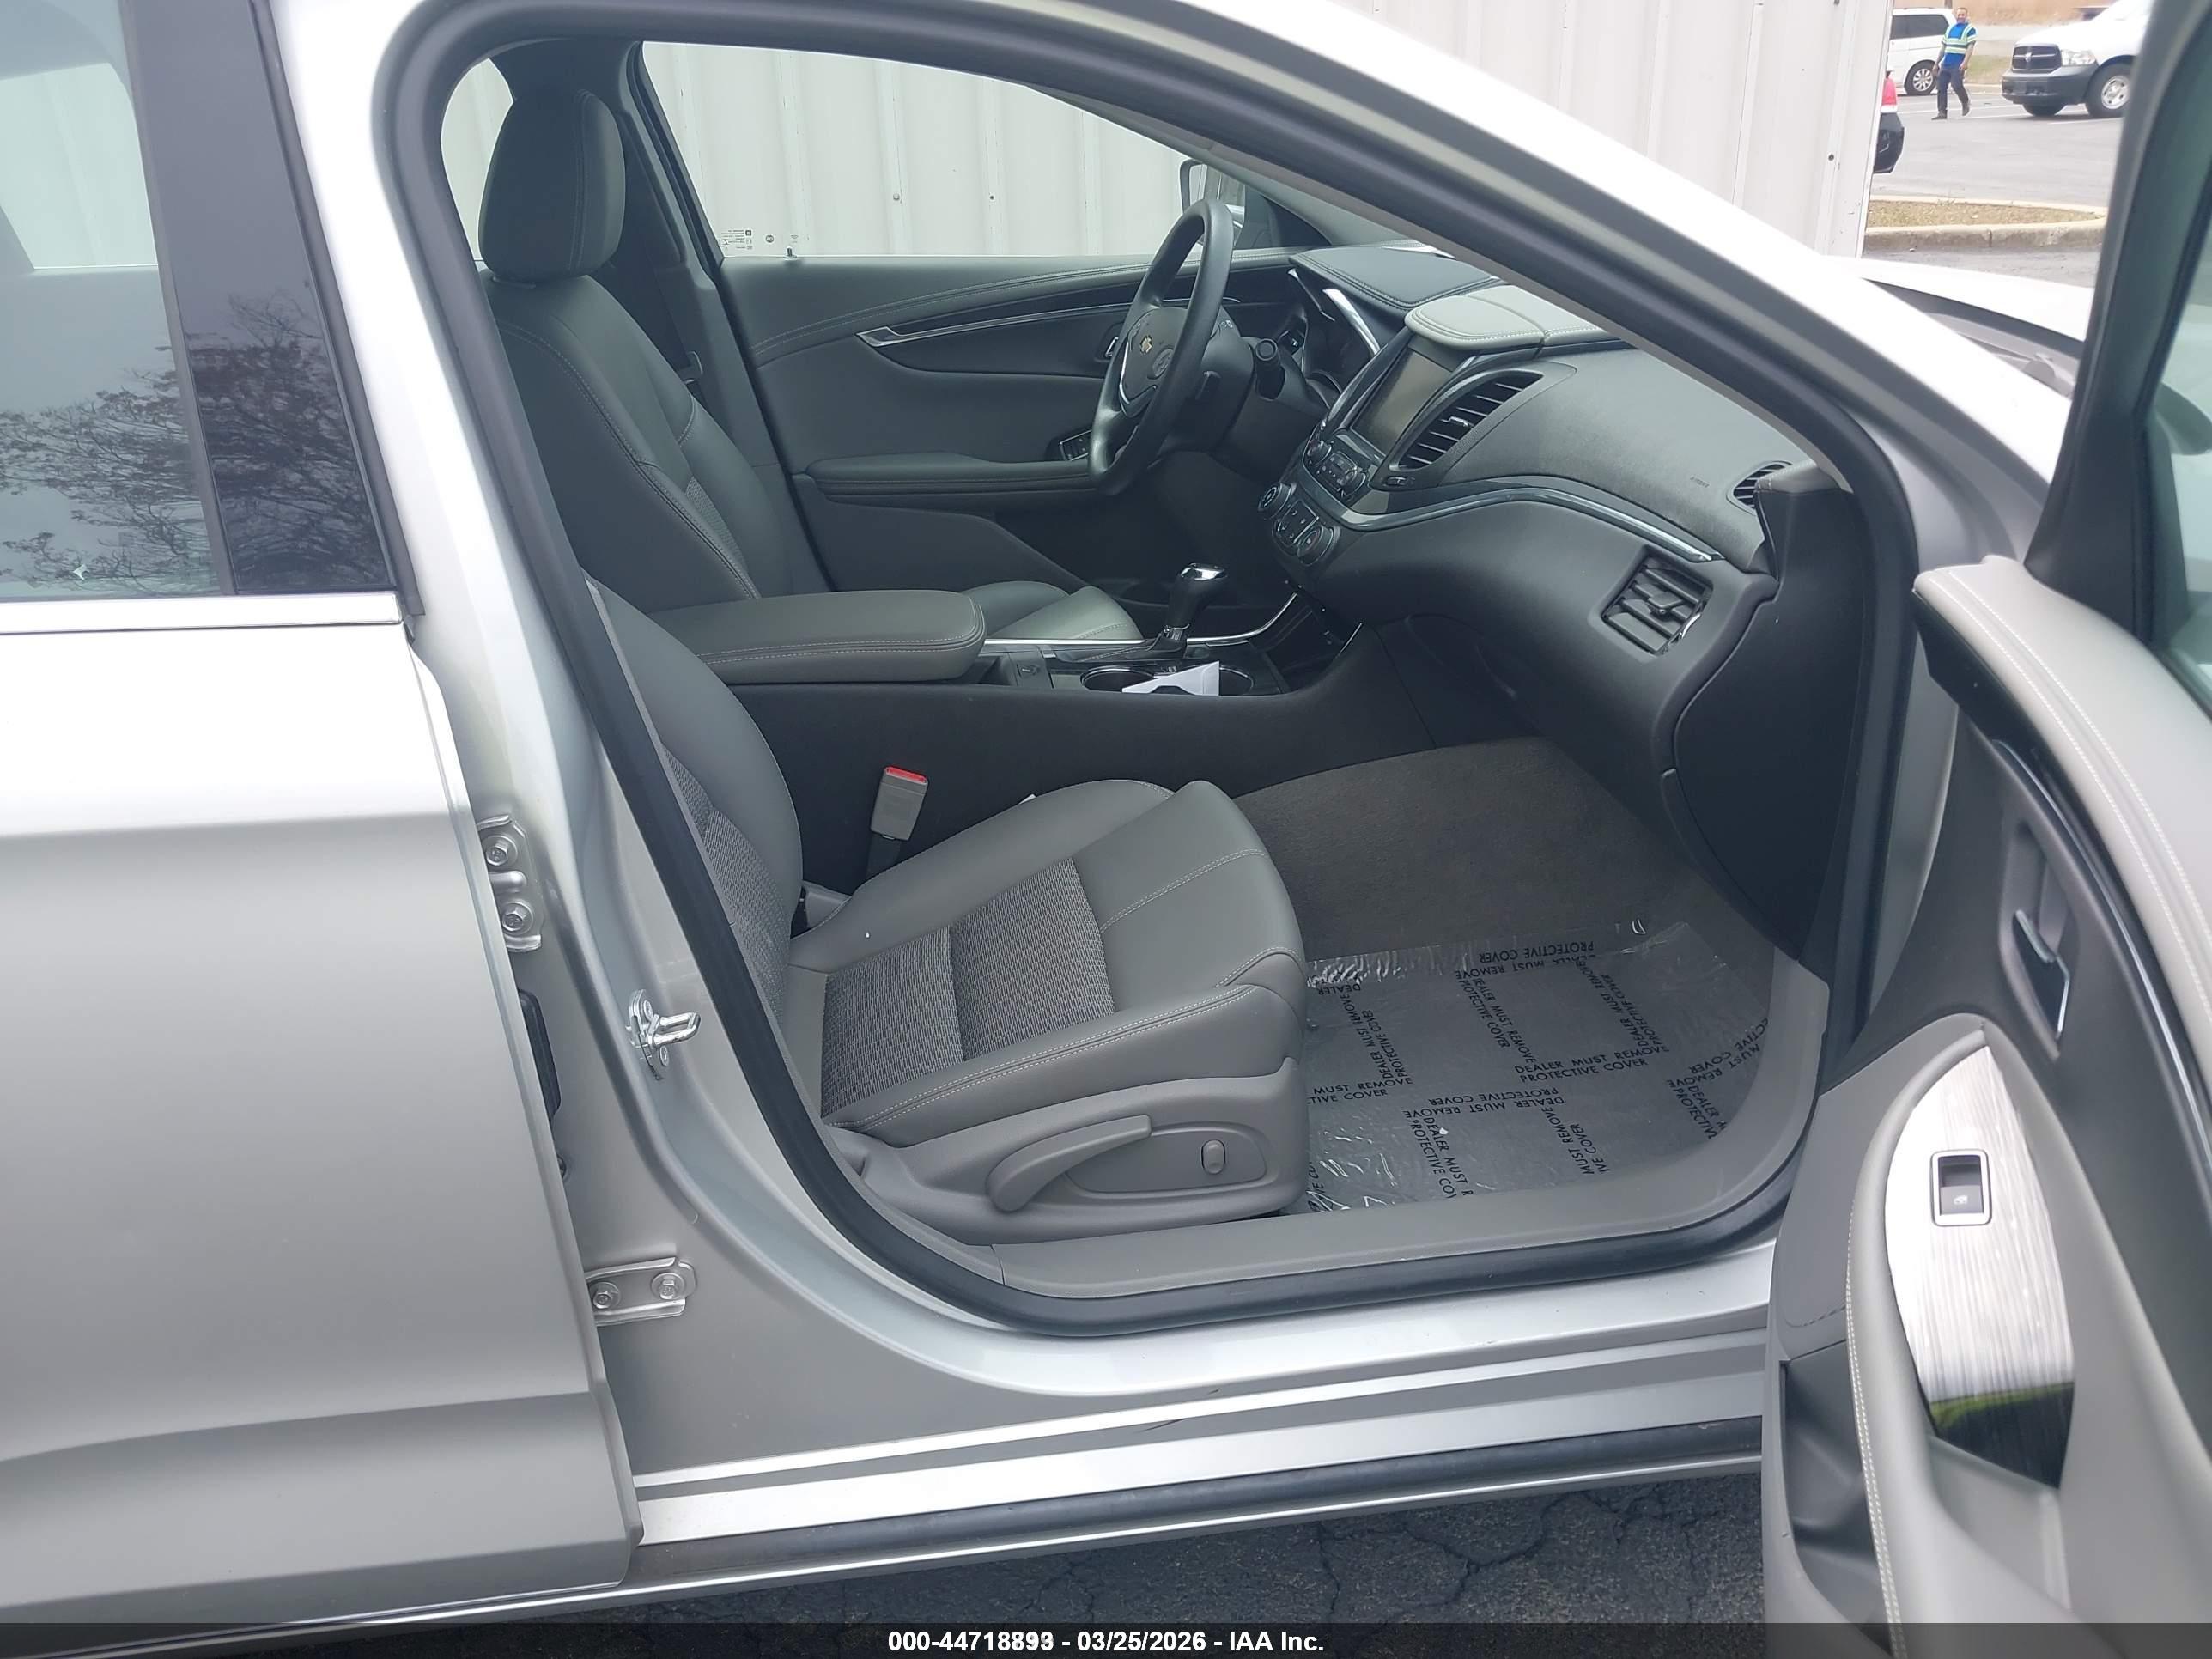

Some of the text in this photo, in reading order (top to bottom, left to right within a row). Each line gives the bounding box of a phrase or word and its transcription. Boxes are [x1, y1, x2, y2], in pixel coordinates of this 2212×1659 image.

[1479, 941, 1595, 963] PROTECTIVE COVER
[1455, 966, 1505, 980] REMOVE
[1513, 961, 1544, 972] MUST
[1318, 983, 1361, 995] DEALER
[1487, 1022, 1510, 1048] COVER
[1492, 1006, 1513, 1027] MUST
[1507, 1030, 1536, 1063] REMOVE
[1620, 1018, 1649, 1047] DEALER
[1370, 1051, 1394, 1079] DEALER
[1376, 1033, 1407, 1078] PROTECTIVE
[1515, 1060, 1564, 1073] DEALER
[1571, 1054, 1607, 1066] MUST
[1689, 1051, 1732, 1073] COVER
[1520, 1058, 1649, 1083] PROTECTIVE COVER
[1666, 1067, 1723, 1088] REMOVE
[1307, 1088, 1388, 1105] TIVE COVER
[1314, 1077, 1413, 1095] MUST REMOVE
[1428, 1087, 1559, 1106] PROTECTIVE COVER
[1402, 1096, 1565, 1118] DEALER MUST REMOVE
[1408, 1119, 1446, 1175] PROTECTIVE
[1541, 1107, 1595, 1175] MUST REMOVE
[1570, 1123, 1596, 1154] COVER
[1424, 1117, 1449, 1152] DEALER
[1443, 1158, 1468, 1183] MUST
